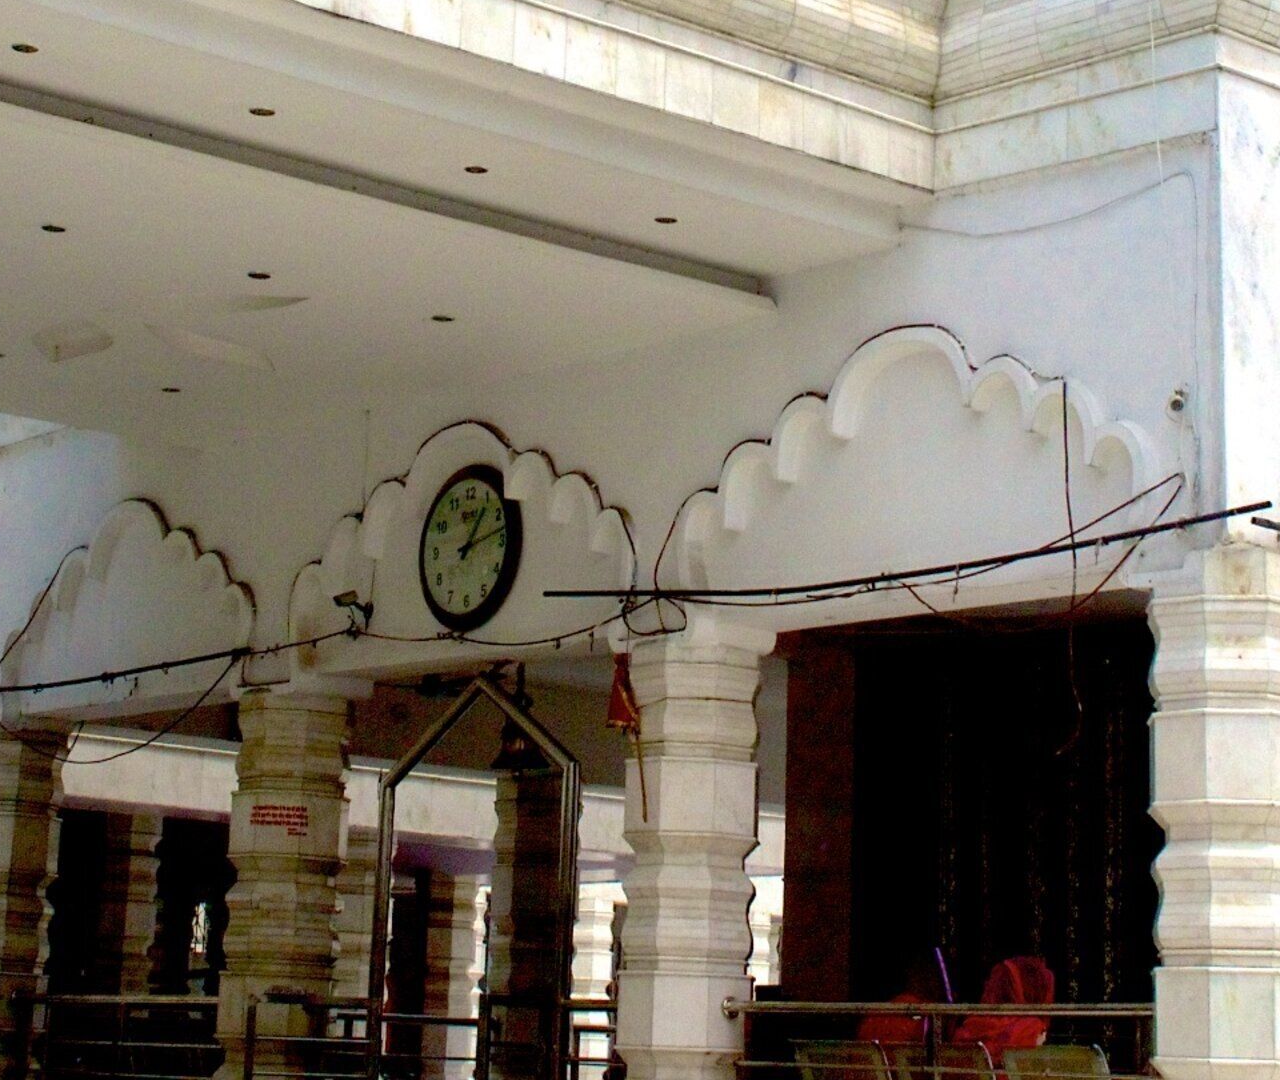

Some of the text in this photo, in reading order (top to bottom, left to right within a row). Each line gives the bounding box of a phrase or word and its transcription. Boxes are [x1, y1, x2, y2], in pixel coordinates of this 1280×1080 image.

[465, 486, 476, 501] 12
[449, 497, 459, 511] 11
[495, 507, 502, 521] 2
[437, 520, 448, 535] 10
[498, 534, 505, 548] 3
[433, 546, 440, 561] 9
[493, 562, 500, 573] 4
[436, 572, 443, 586] 8
[447, 590, 454, 605] 7
[480, 584, 487, 598] 5
[463, 594, 470, 608] 6
